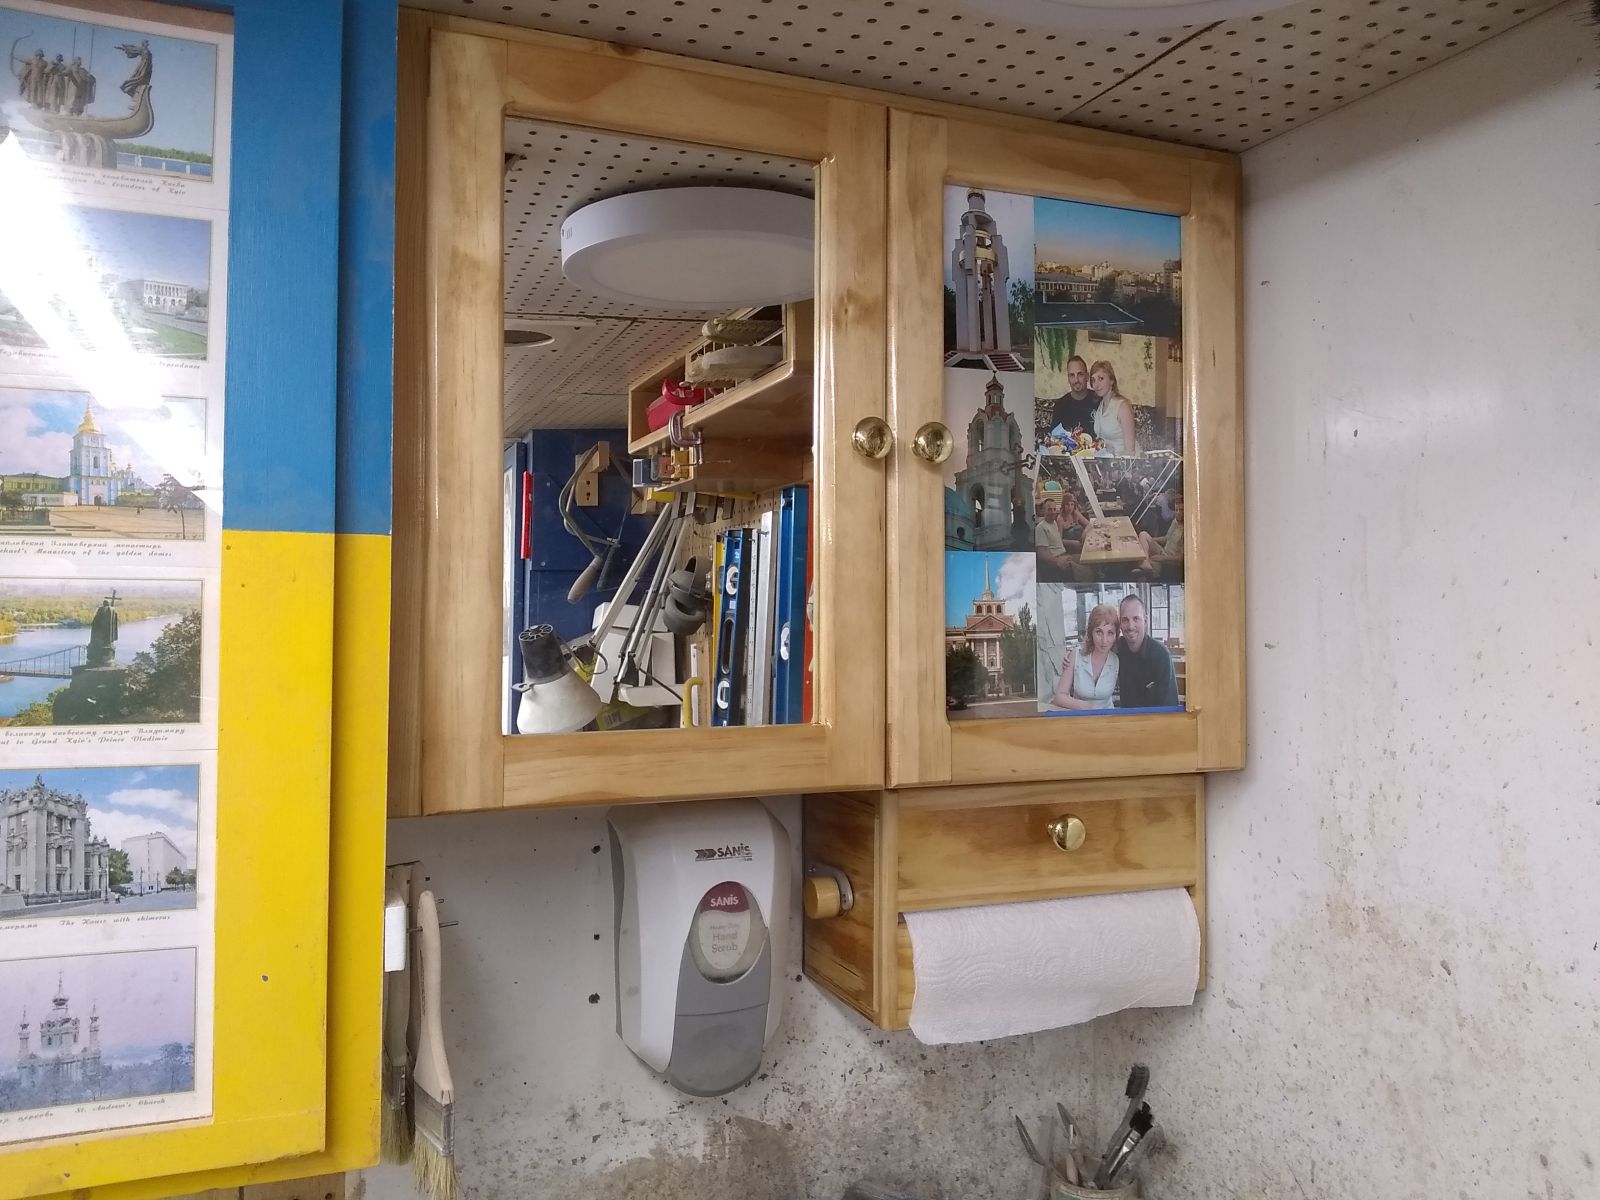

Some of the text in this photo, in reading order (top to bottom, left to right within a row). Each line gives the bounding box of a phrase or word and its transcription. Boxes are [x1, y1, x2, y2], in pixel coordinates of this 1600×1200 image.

[0, 538, 45, 547] айловский
[0, 547, 27, 555] chael's
[36, 548, 76, 556] Monastery
[116, 550, 142, 558] golden
[66, 737, 92, 745] Kyiv's
[98, 736, 125, 745] Prince
[131, 735, 168, 743] Vladimir
[82, 918, 107, 926] House
[113, 916, 130, 924] with
[0, 923, 38, 931] мерами
[712, 931, 738, 941] Hand
[711, 942, 738, 954] Scrub
[93, 1102, 132, 1112] Andrew's
[138, 1098, 166, 1106] Church
